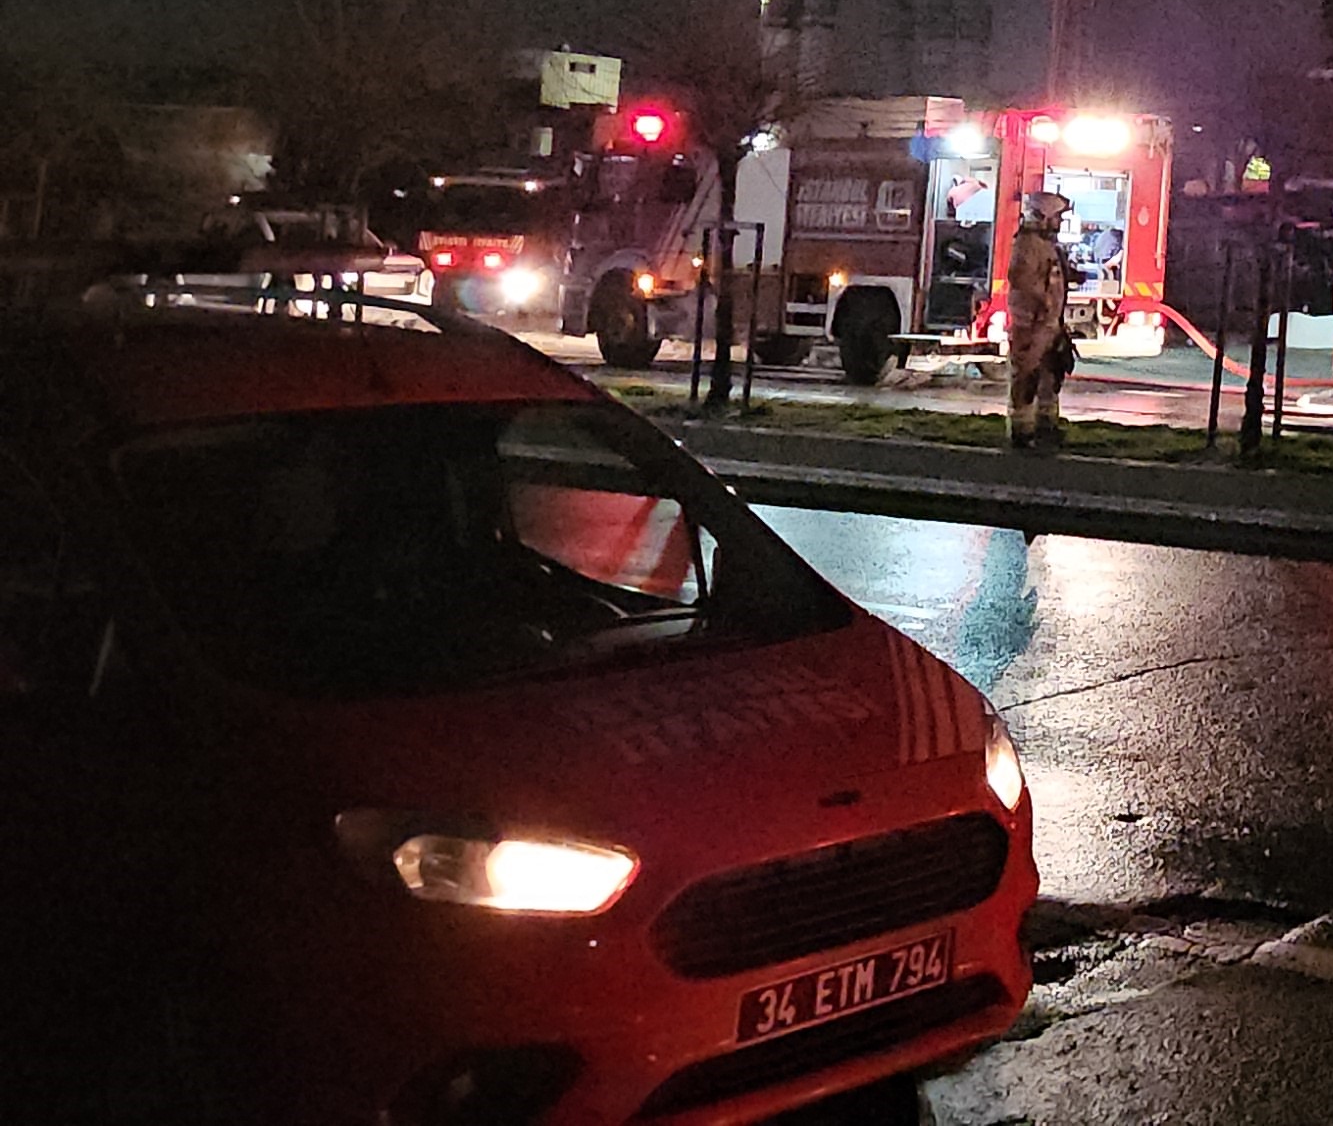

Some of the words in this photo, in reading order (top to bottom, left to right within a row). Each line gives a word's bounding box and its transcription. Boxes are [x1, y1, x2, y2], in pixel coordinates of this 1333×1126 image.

[755, 983, 797, 1033] 34
[815, 959, 876, 1016] ETM
[889, 938, 943, 993] 794
